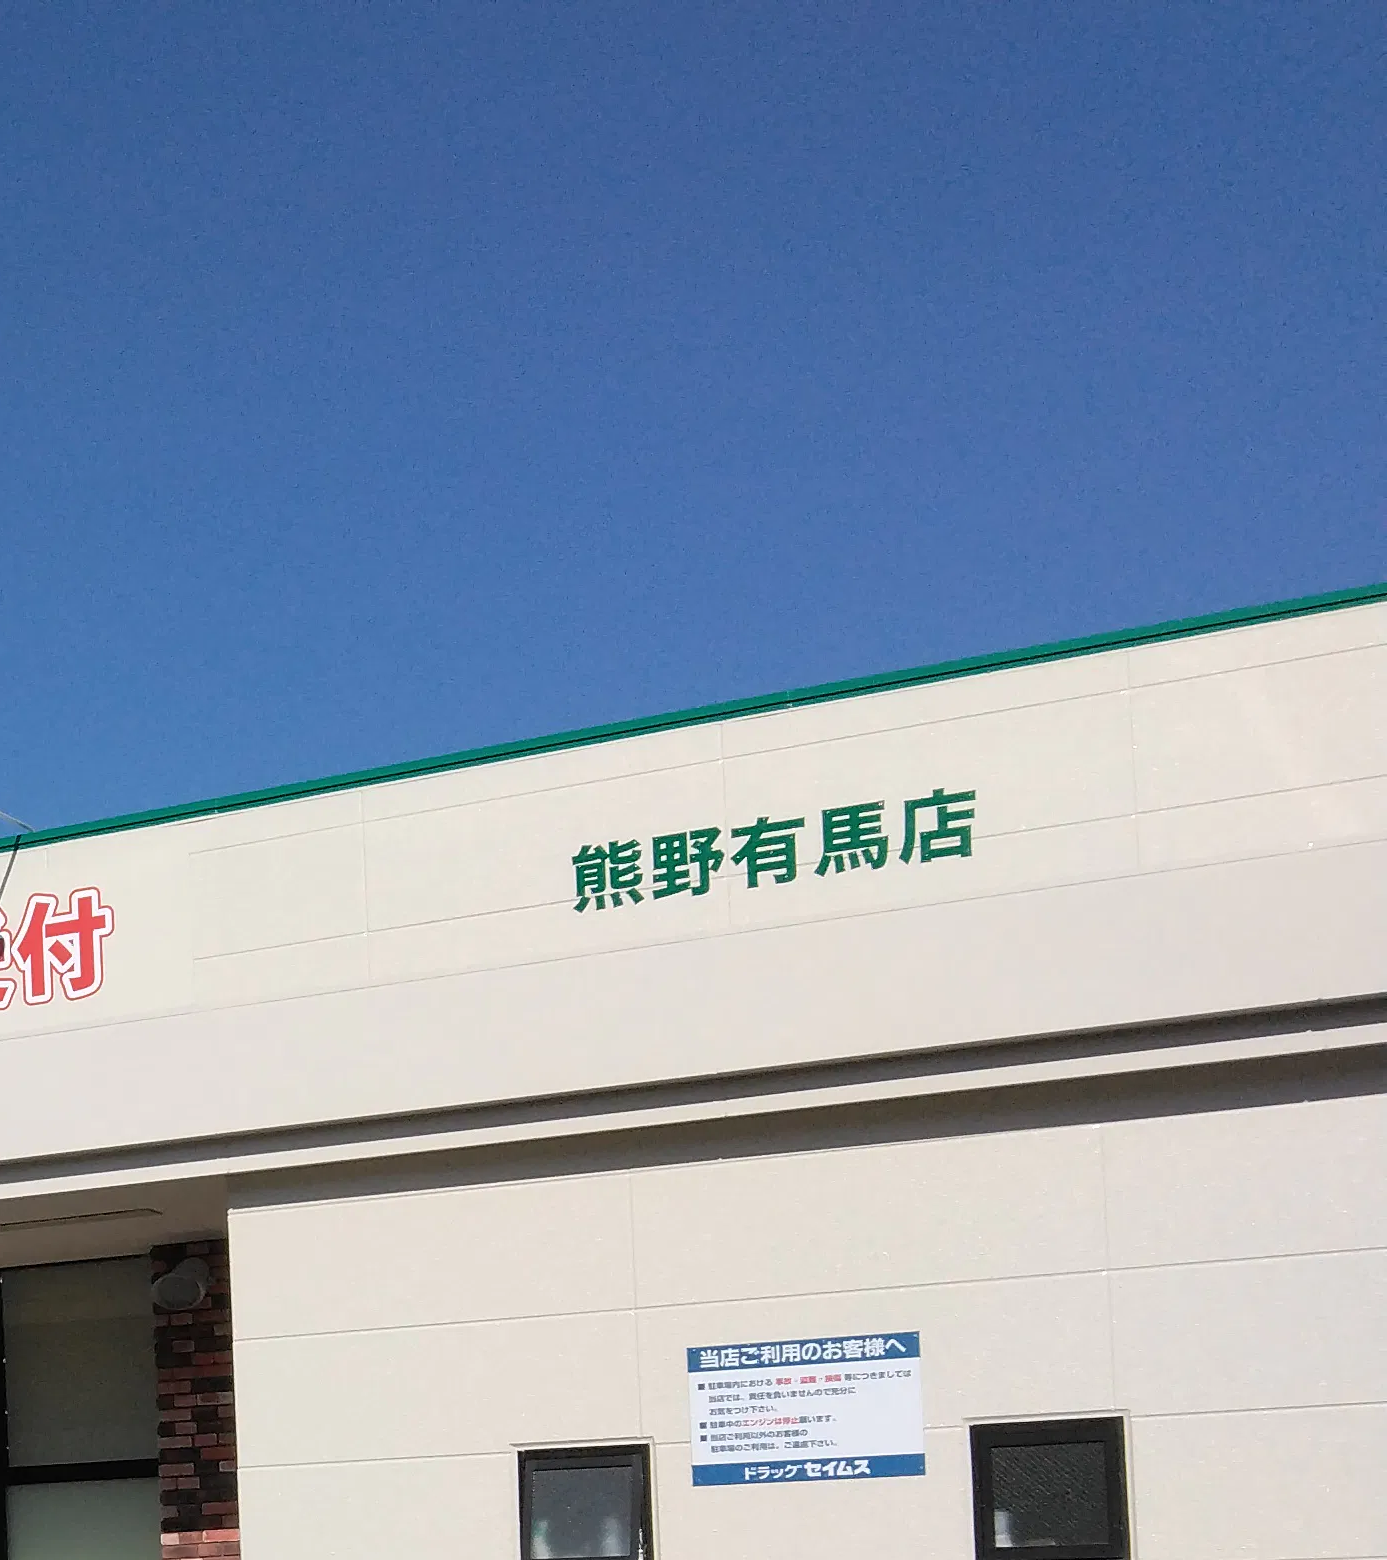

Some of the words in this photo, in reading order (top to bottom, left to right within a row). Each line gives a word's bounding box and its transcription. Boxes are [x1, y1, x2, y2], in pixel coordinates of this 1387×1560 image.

[571, 786, 977, 914] 熊野有馬店
[699, 1338, 907, 1369] 当店ご利用のお客様へ
[744, 1465, 801, 1481] ドラッグ
[803, 1458, 872, 1478] セイムス
